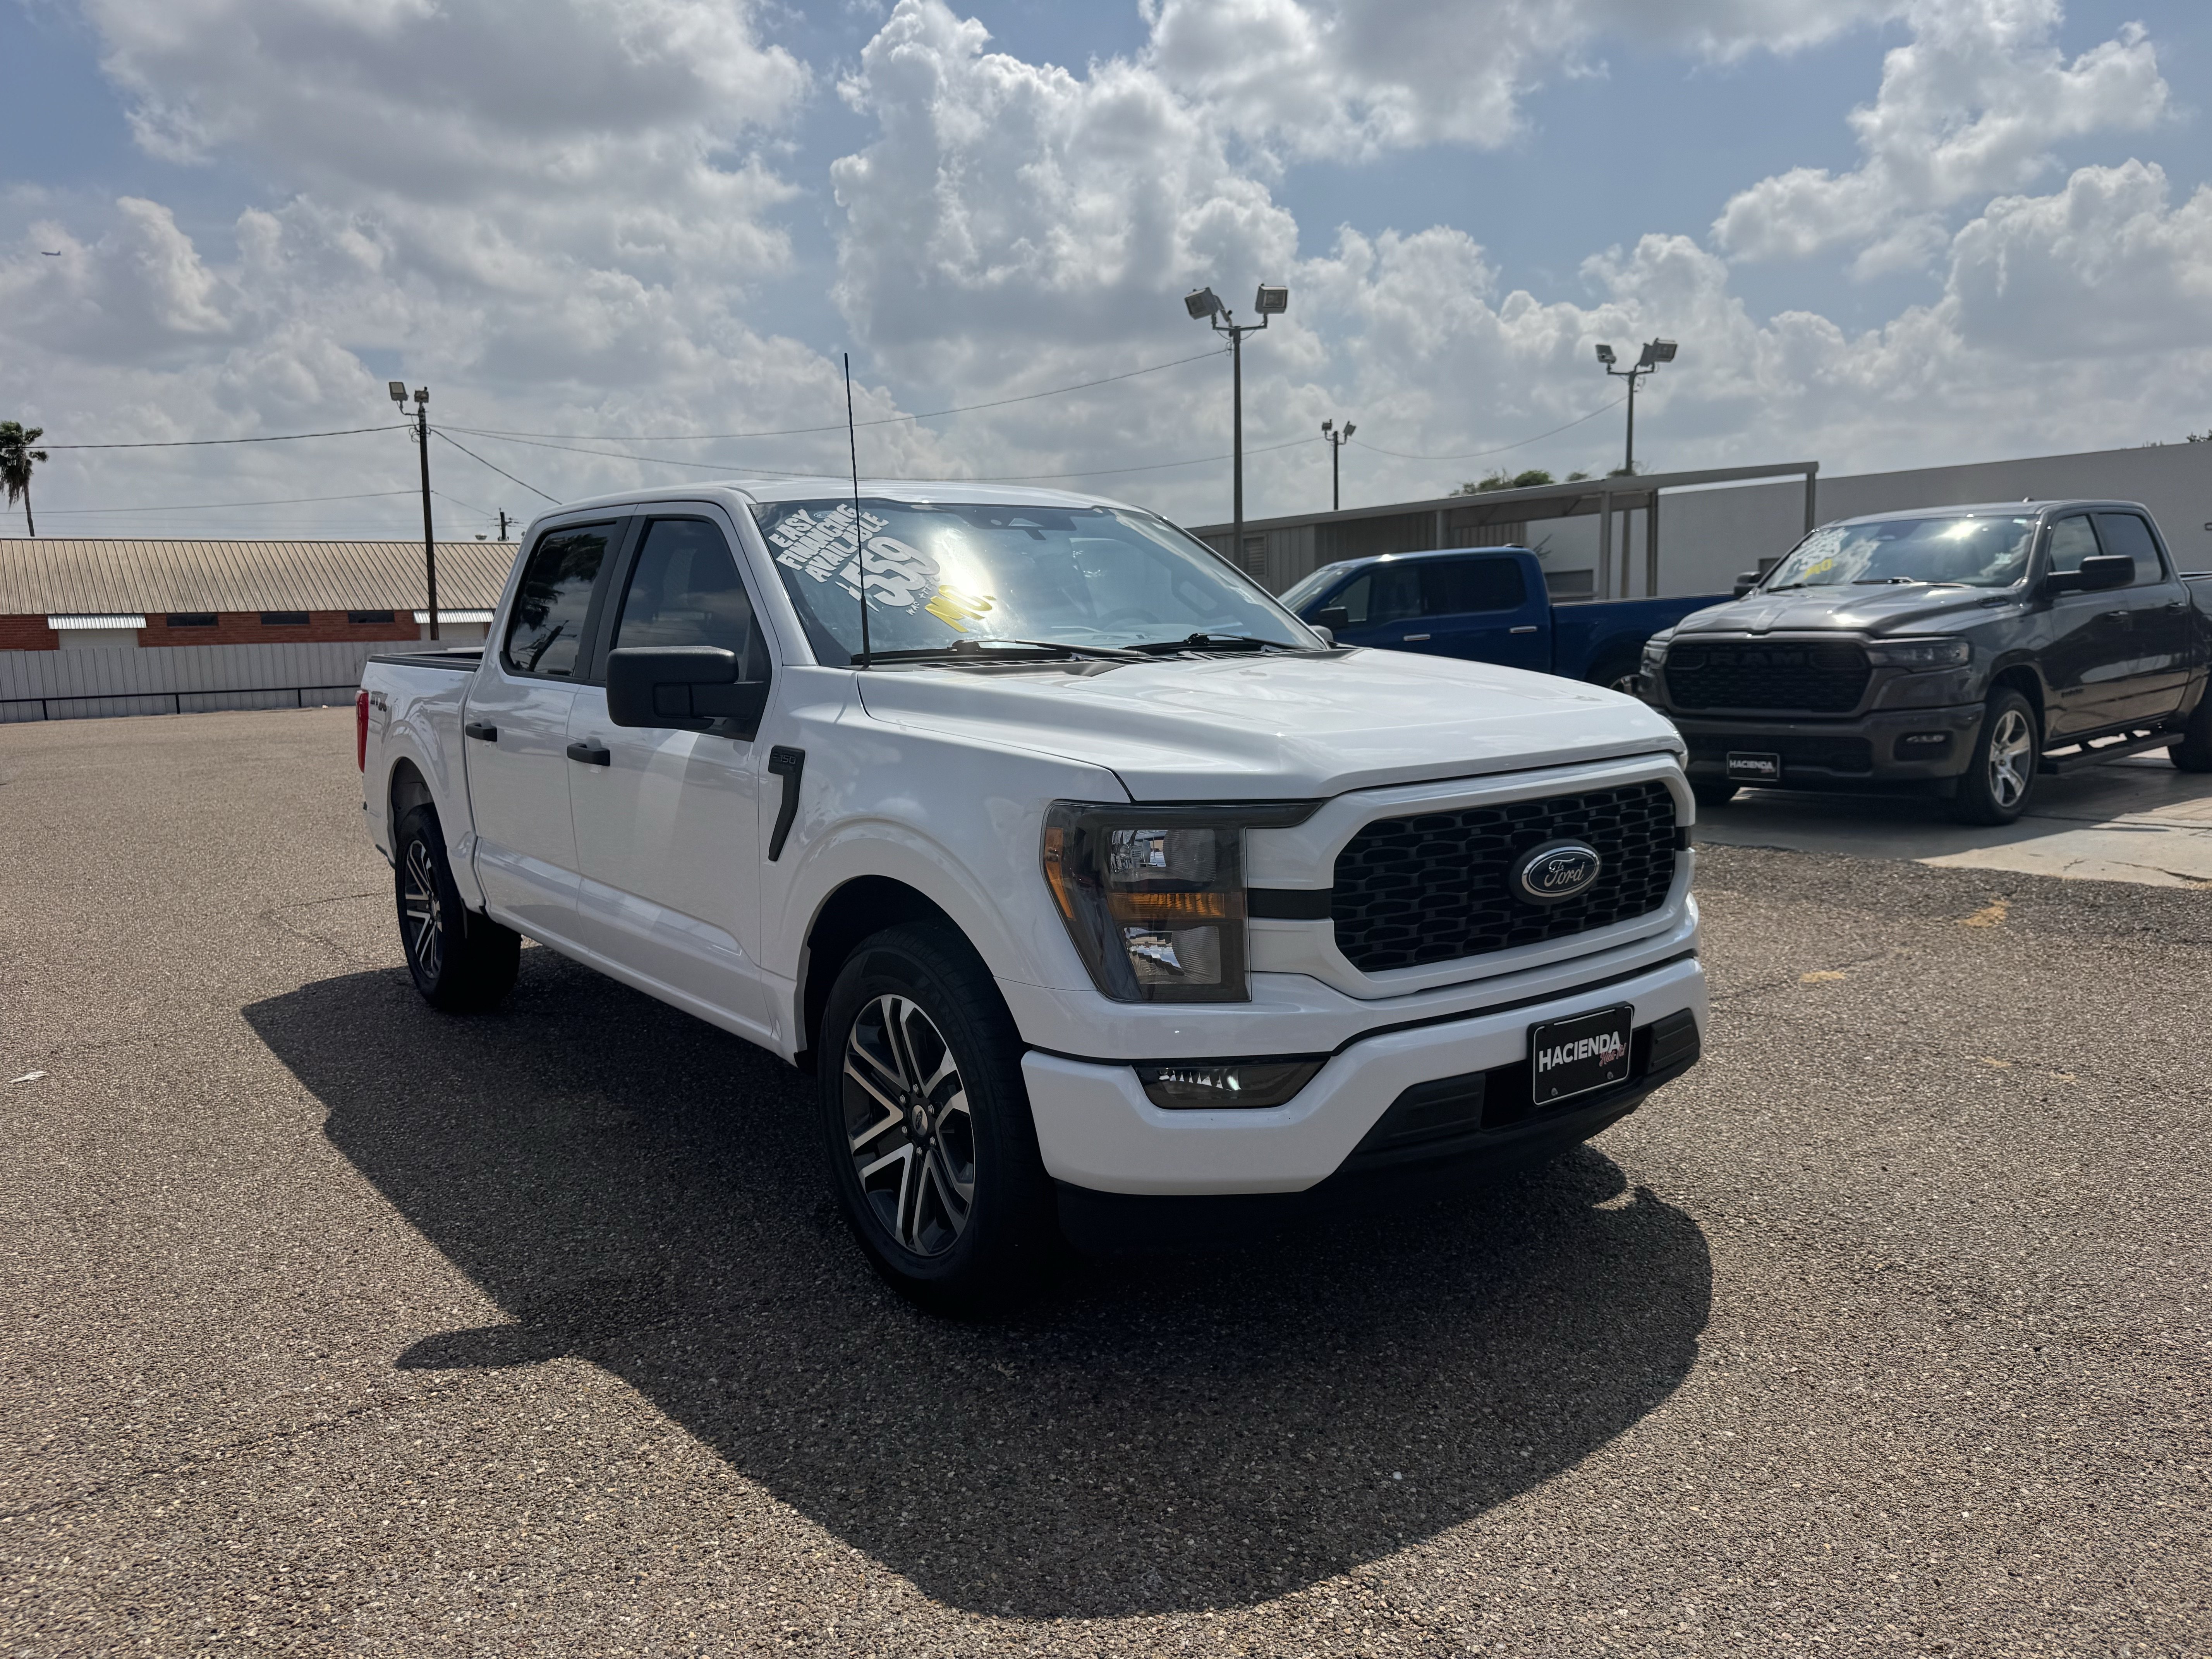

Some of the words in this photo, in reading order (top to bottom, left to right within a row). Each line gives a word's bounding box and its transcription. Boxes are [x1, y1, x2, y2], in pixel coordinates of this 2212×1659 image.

[768, 509, 817, 548] EASY
[776, 503, 862, 570] FINANCING
[805, 512, 889, 583] AVAILABLE
[906, 601, 920, 616] WAC
[1729, 759, 1772, 769] HACIENDA
[1544, 858, 1585, 887] Ford
[1539, 1031, 1620, 1072] HACIENDA
